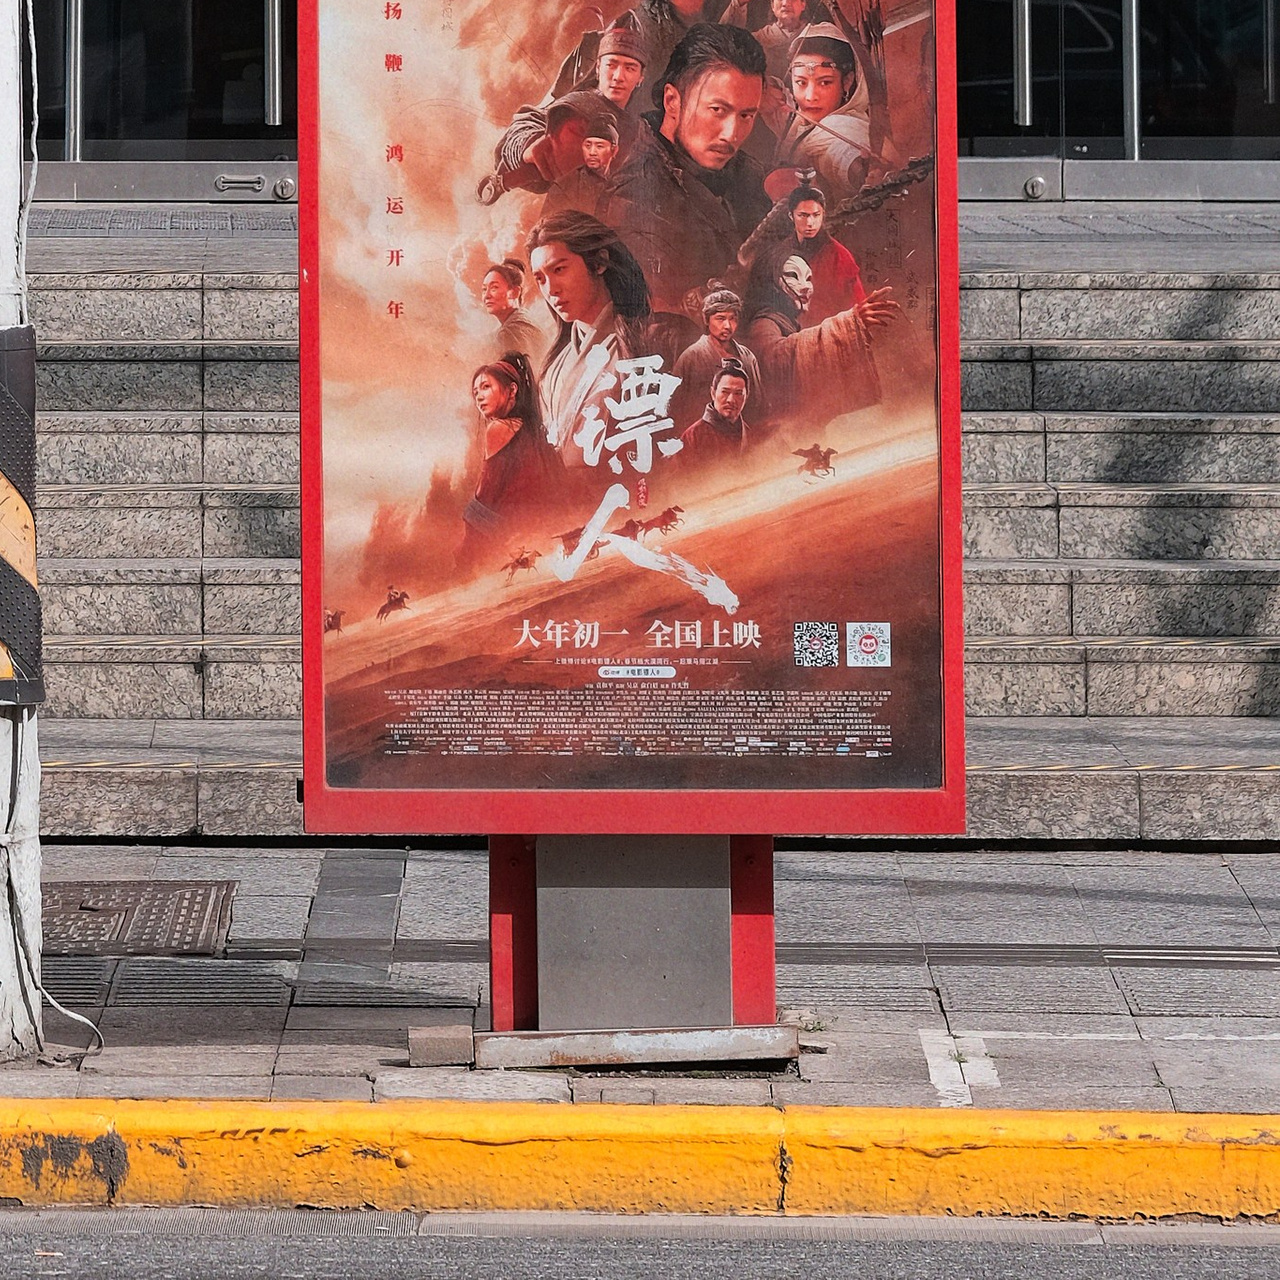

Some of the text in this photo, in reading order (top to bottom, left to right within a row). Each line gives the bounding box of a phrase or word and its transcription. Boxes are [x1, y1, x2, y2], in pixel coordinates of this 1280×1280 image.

[386, 144, 404, 319] 鸿运开年
[512, 619, 762, 649] 大年初一 全国上映
